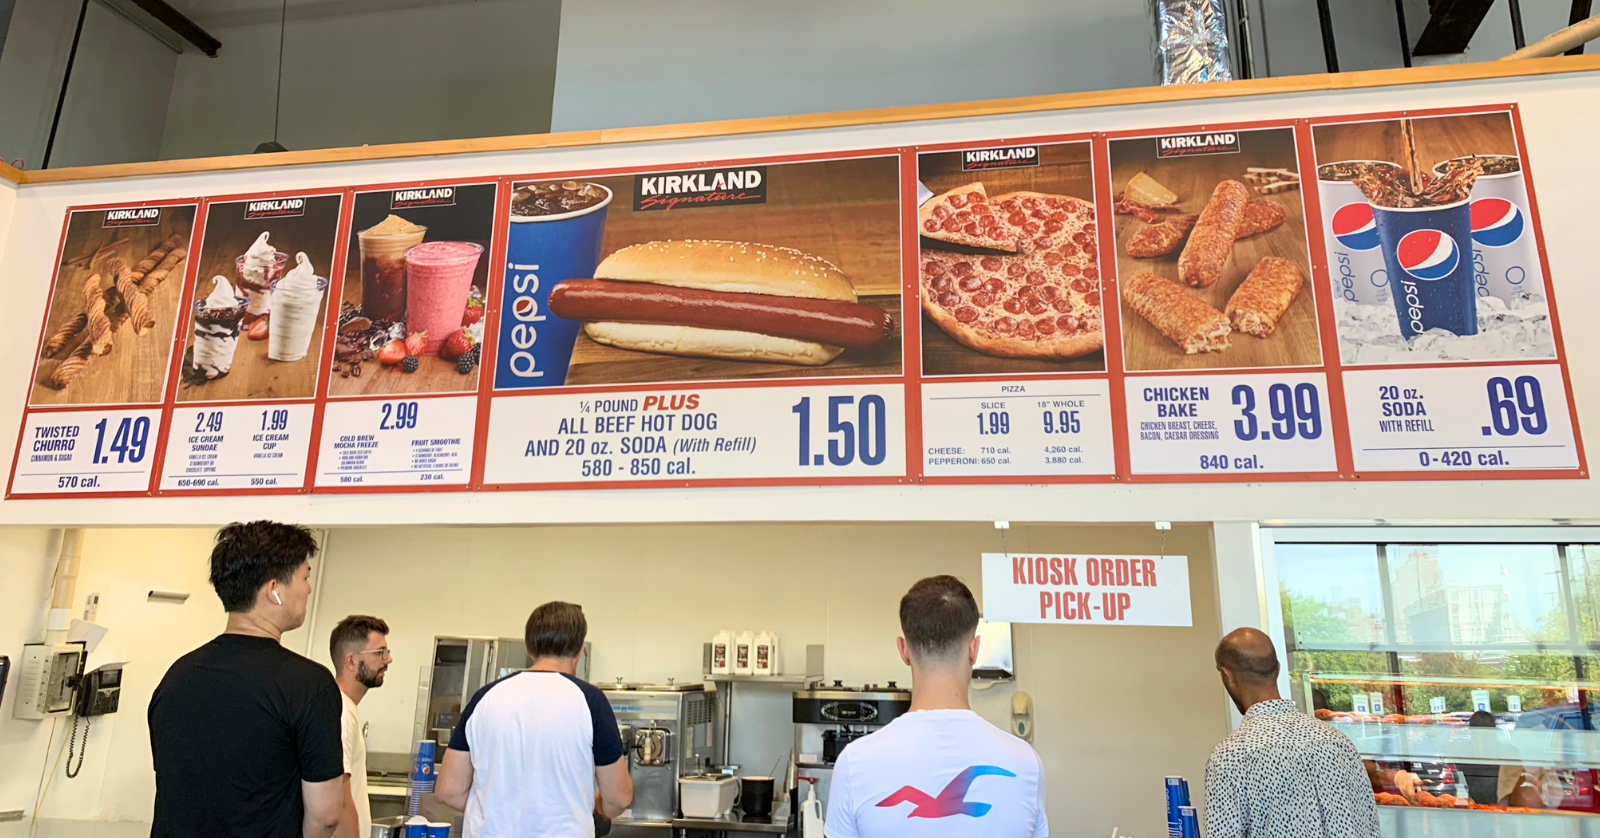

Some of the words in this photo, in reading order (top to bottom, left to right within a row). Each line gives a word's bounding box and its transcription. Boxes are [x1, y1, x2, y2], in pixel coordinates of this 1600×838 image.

[1161, 134, 1236, 149] KIRKLAND
[966, 148, 1036, 162] KIRKLAND
[1162, 146, 1236, 157] Signature
[966, 159, 1036, 170] Signature
[642, 170, 762, 196] KIRKLAND
[395, 188, 452, 201] KIRKLAND
[640, 191, 761, 210] Signature
[249, 199, 303, 212] KIRKLAND
[395, 199, 452, 208] Signature
[107, 209, 159, 220] KIRKLAND
[248, 209, 301, 218] Signature
[107, 218, 157, 226] Signature
[1334, 252, 1360, 302] pepsi
[1400, 279, 1425, 334] pepsi
[508, 262, 546, 378] pepsi
[1143, 387, 1210, 402] CHICKEN
[1379, 386, 1400, 400] 20
[1404, 387, 1423, 400] oz.
[594, 399, 638, 413] POUND
[642, 394, 700, 411] PLUS
[1157, 404, 1198, 418] BAKE
[1232, 382, 1323, 441] 3.99
[1382, 401, 1427, 416] SODA
[1481, 375, 1548, 437] .69
[195, 412, 223, 433] 2.49
[261, 409, 288, 431] 1.99
[380, 402, 418, 430] 2.99
[558, 417, 592, 435] ALL
[595, 416, 636, 433] BEEF
[640, 414, 675, 432] HOT
[681, 413, 718, 431] DOG
[976, 411, 1010, 435] 1.99
[1043, 410, 1080, 434] 9.95
[35, 426, 80, 438] TWISTED
[792, 394, 886, 466] 1.50
[1140, 422, 1166, 430] CHICKEN
[1168, 421, 1192, 431] BREAST,
[1193, 421, 1217, 430] CHEESE,
[1380, 419, 1403, 433] WITH
[1405, 418, 1434, 432] REFILL
[92, 416, 150, 464] 1.49
[1140, 432, 1162, 441] BACON,
[1164, 431, 1188, 440] CAESAR
[1189, 431, 1219, 440] DRESSING
[33, 439, 75, 452] CHURRO
[525, 439, 559, 456] AND
[565, 439, 585, 455] 20
[591, 440, 613, 454] oz.
[620, 437, 666, 454] SODA
[673, 438, 711, 456] (With
[714, 436, 757, 455] Refill)
[581, 459, 612, 476] 580
[630, 458, 660, 475] 850
[666, 456, 695, 475] cal.
[1200, 455, 1228, 470] 840
[1234, 454, 1264, 469] cal.
[1478, 450, 1510, 467] cal.
[58, 476, 78, 488] 570
[81, 475, 100, 487] cal.
[1012, 557, 1078, 586] KIOSK
[1086, 558, 1157, 587] ORDER
[1039, 591, 1132, 621] PICK-UP
